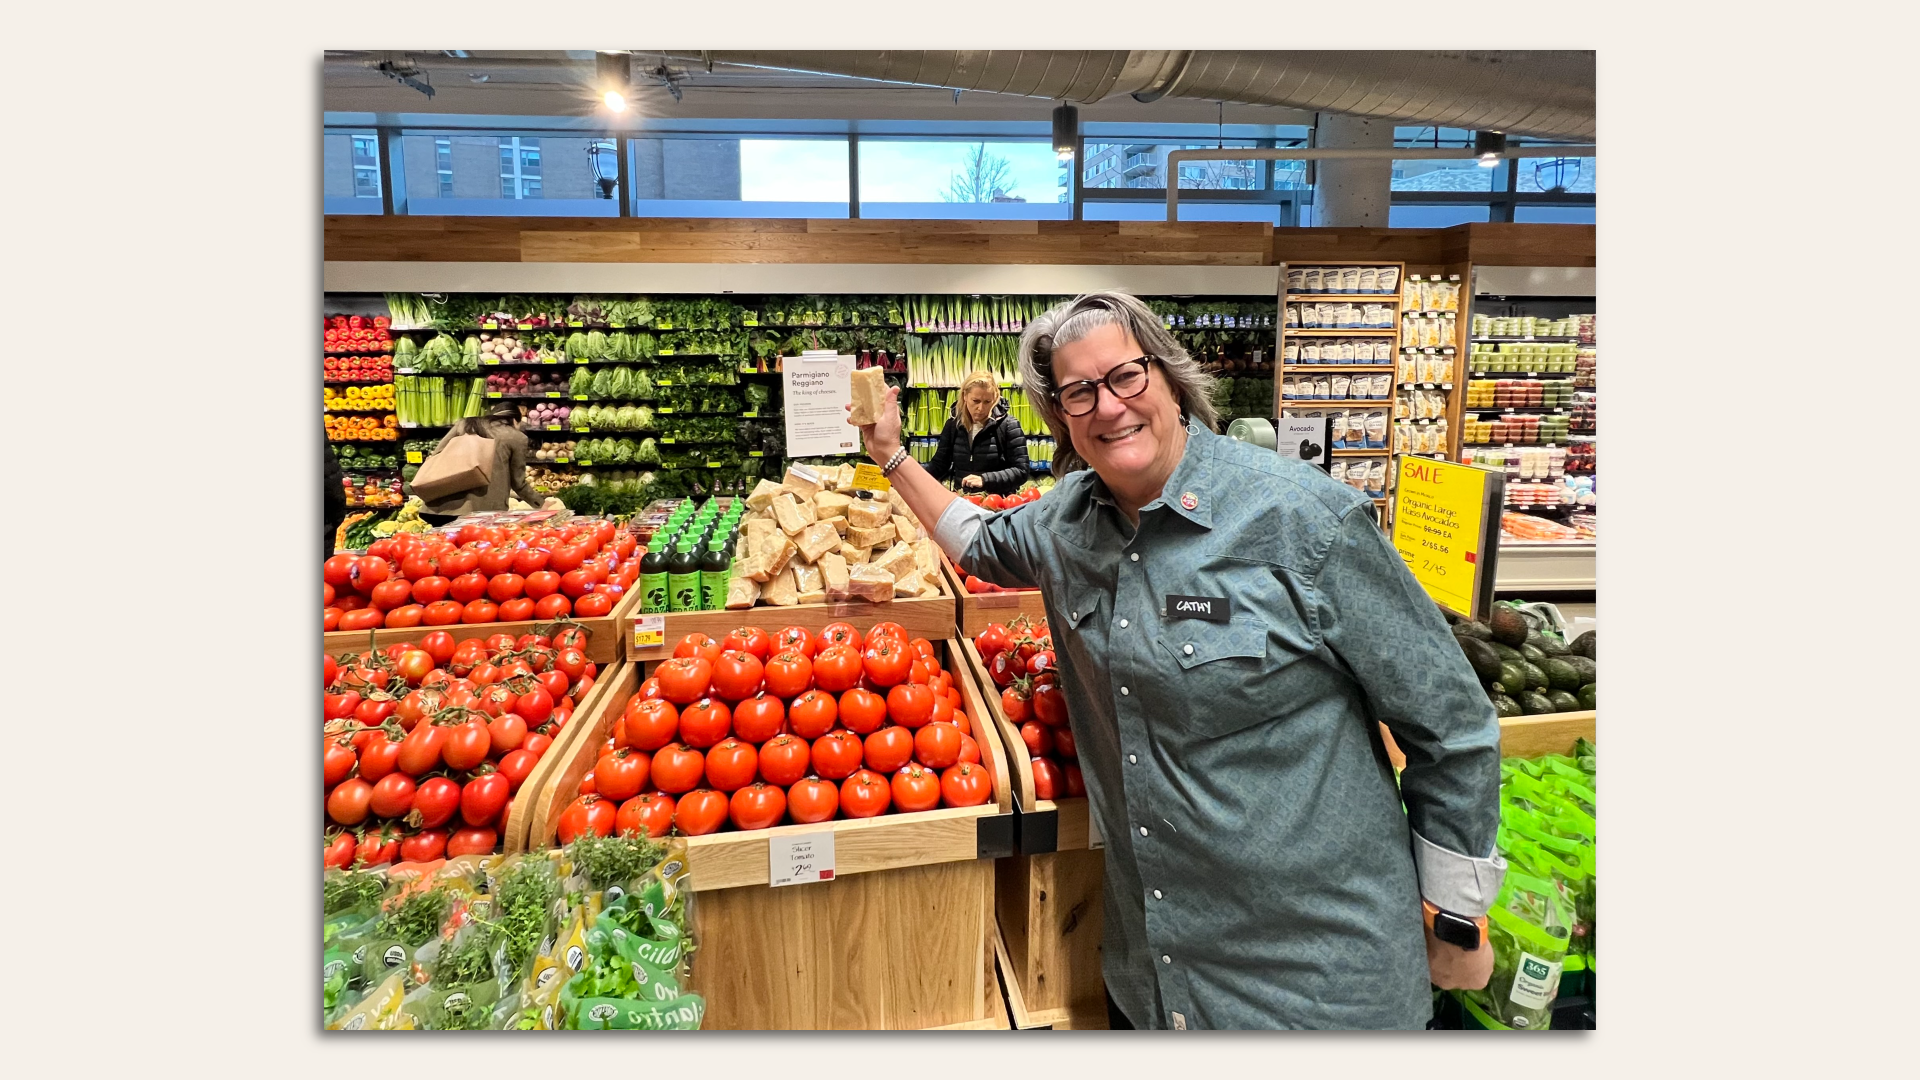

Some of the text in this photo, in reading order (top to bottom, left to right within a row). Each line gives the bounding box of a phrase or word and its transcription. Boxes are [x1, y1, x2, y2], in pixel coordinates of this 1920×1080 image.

[791, 371, 830, 379] Parmigiano
[792, 379, 824, 387] Reggiano
[1404, 462, 1445, 484] SALE
[1402, 496, 1457, 518] Organic Large
[1402, 505, 1460, 529] Hass Avocados
[1442, 530, 1453, 540] EA
[1398, 548, 1415, 558] prime
[1422, 539, 1449, 554] 2/$5.56
[1176, 600, 1211, 614] CATHY
[635, 634, 651, 643] $17.79
[790, 853, 815, 861] Tomato
[1526, 962, 1548, 976] 365
[1519, 976, 1544, 990] Organic
